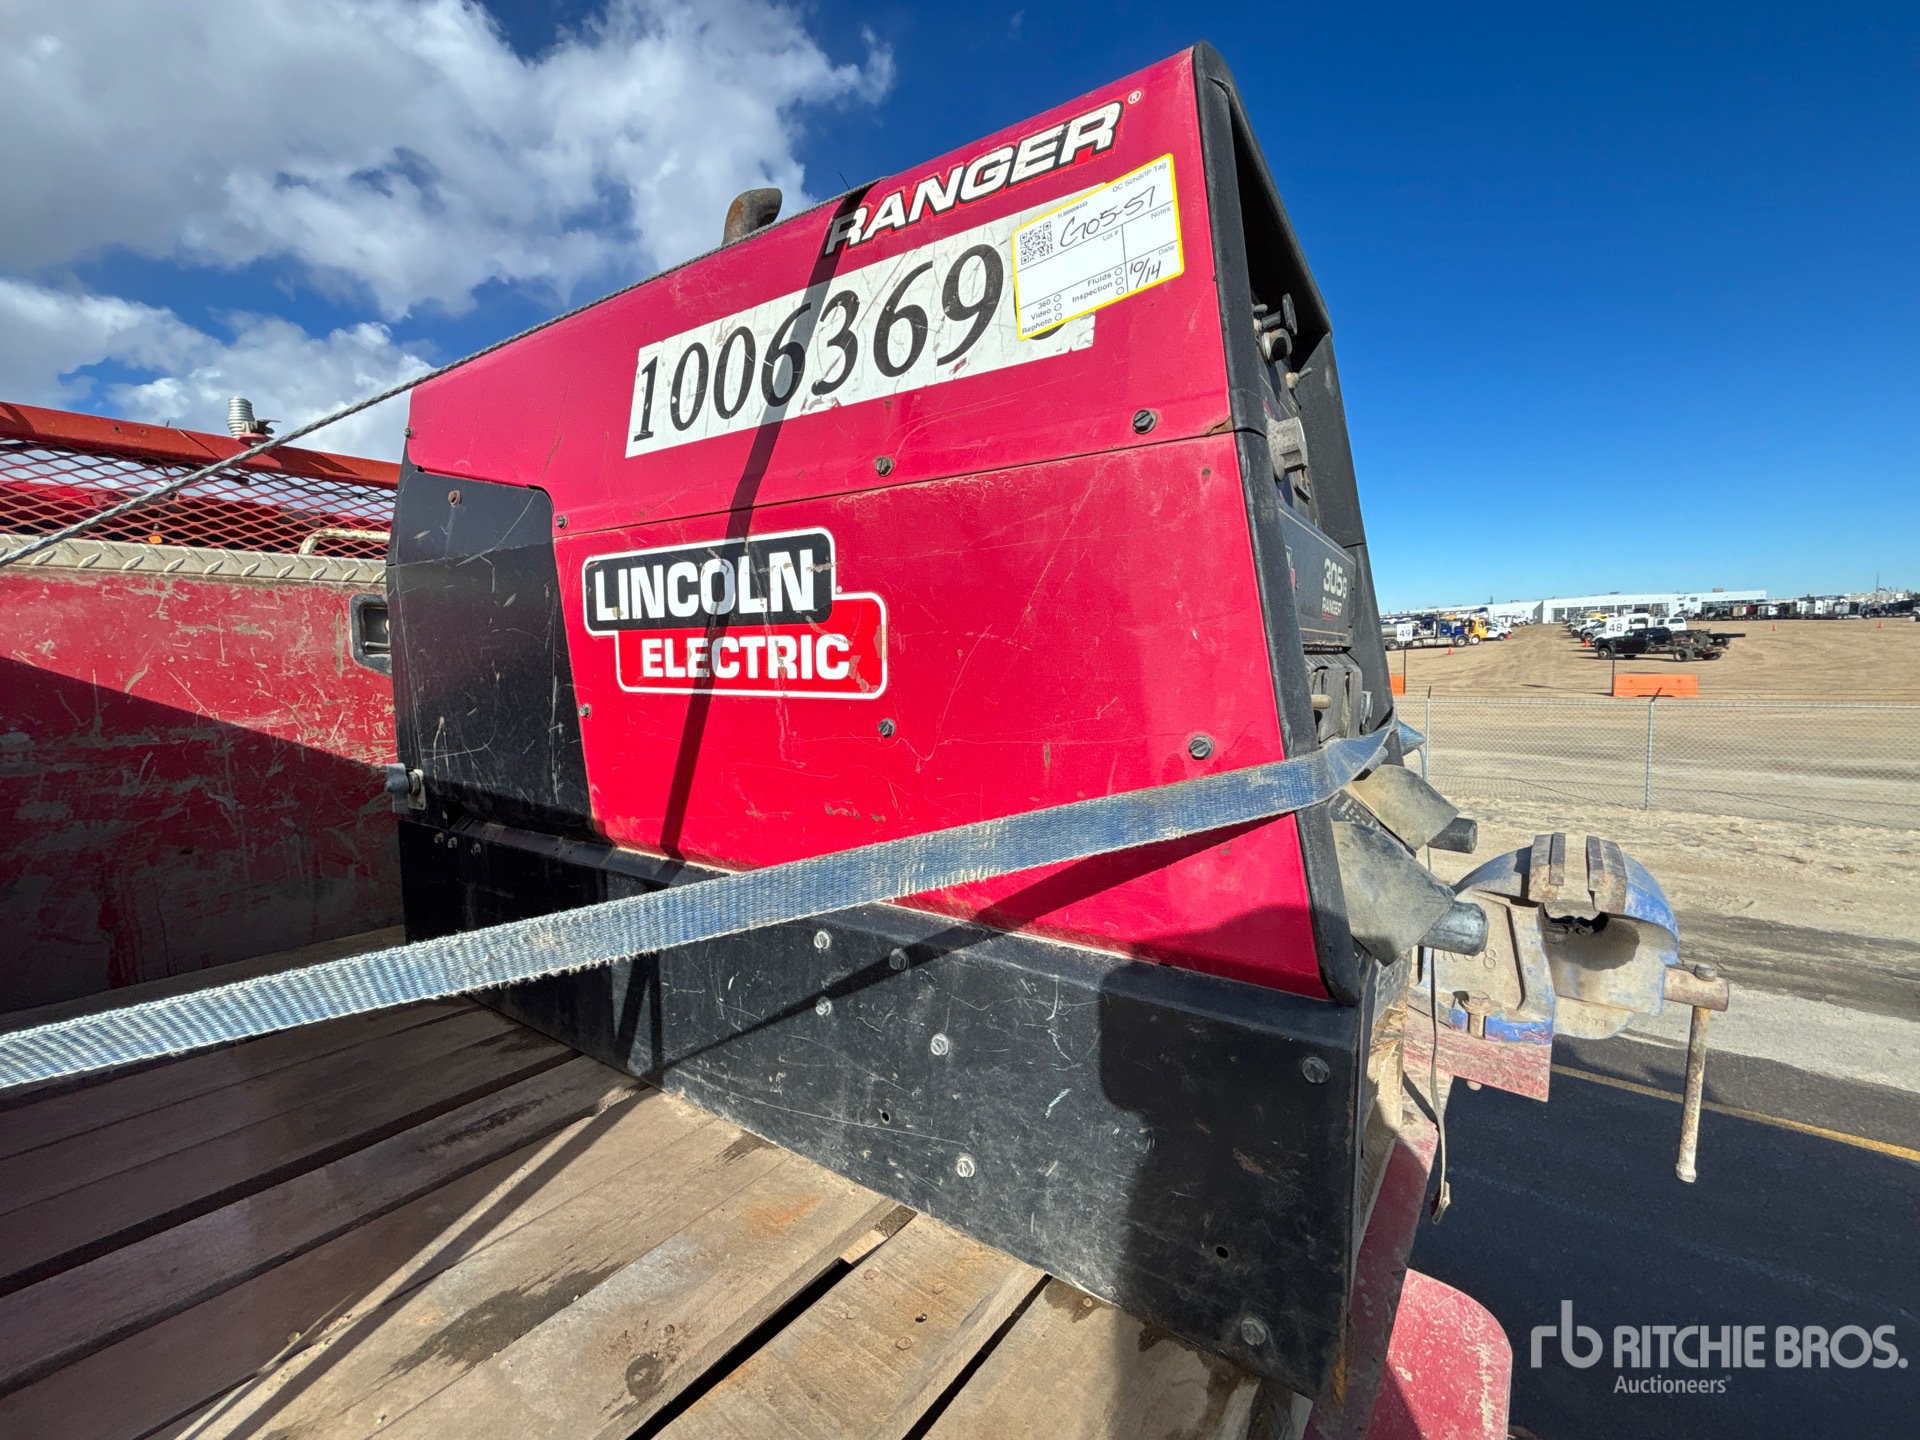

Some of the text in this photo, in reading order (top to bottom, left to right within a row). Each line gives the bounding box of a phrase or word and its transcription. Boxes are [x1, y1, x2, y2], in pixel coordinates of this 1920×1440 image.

[1112, 183, 1123, 193] OC
[1154, 162, 1167, 174] Tag
[1150, 206, 1172, 219] Notes
[1102, 233, 1114, 242] Lot
[1158, 244, 1175, 256] Date
[1087, 273, 1112, 287] Fluids
[1129, 257, 1162, 289] 10/14
[1072, 281, 1113, 303] Inspection
[1038, 298, 1051, 310] 360
[1030, 308, 1052, 321] Video
[1021, 317, 1052, 335] Rephoto
[633, 244, 1063, 441] 1006369
[594, 548, 817, 622] LINCOLN
[1399, 629, 1411, 637] 49
[1608, 623, 1623, 632] 48
[641, 633, 851, 681] ELECTRIC
